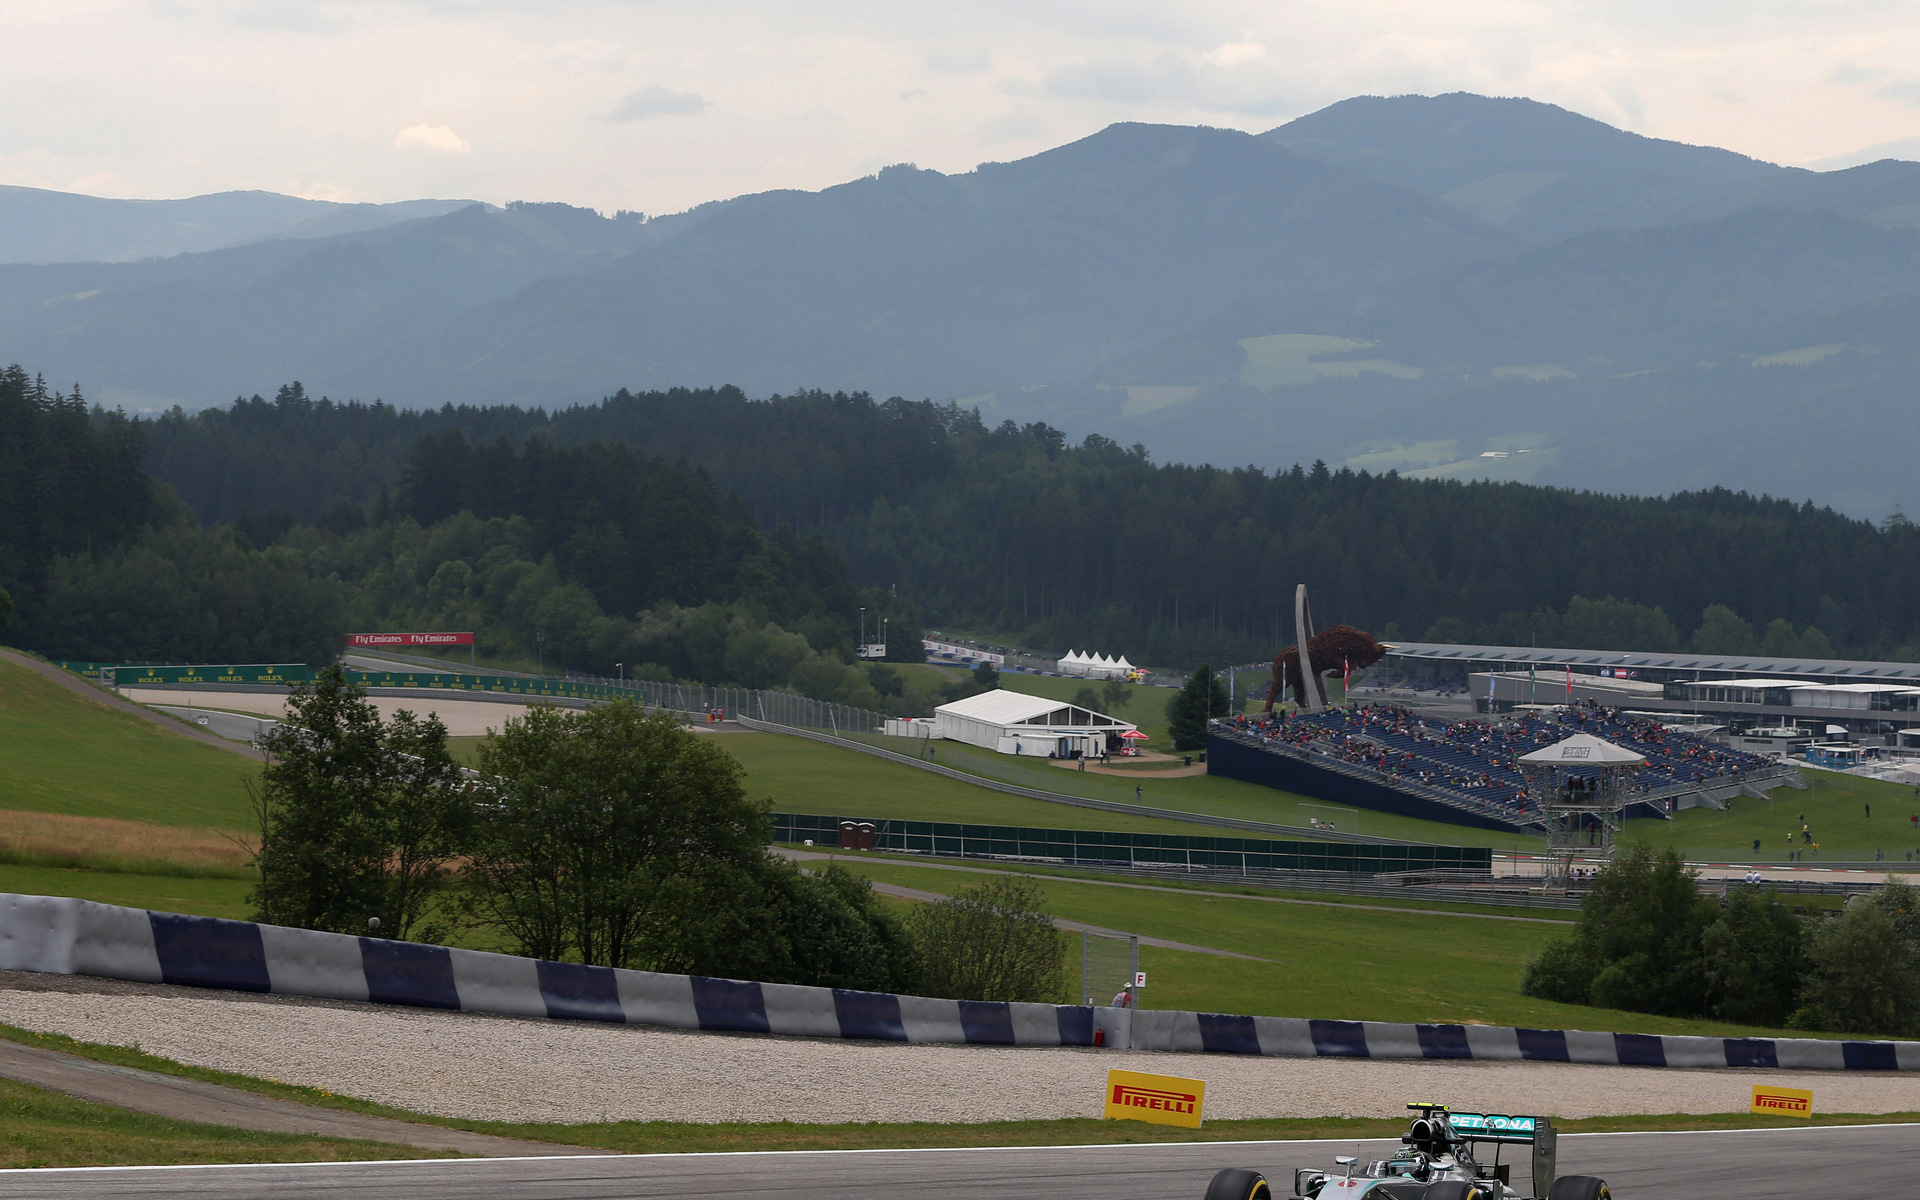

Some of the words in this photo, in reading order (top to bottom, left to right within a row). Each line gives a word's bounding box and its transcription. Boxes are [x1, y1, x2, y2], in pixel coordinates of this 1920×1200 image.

[355, 635, 368, 644] Fly
[369, 635, 402, 643] Emirates
[411, 634, 424, 644] Fly
[424, 634, 457, 643] Emirates
[1137, 975, 1144, 984] F
[1112, 1085, 1196, 1114] PIRELLI
[1755, 1094, 1808, 1111] PIRELLI
[1449, 1115, 1534, 1130] PETRONA
